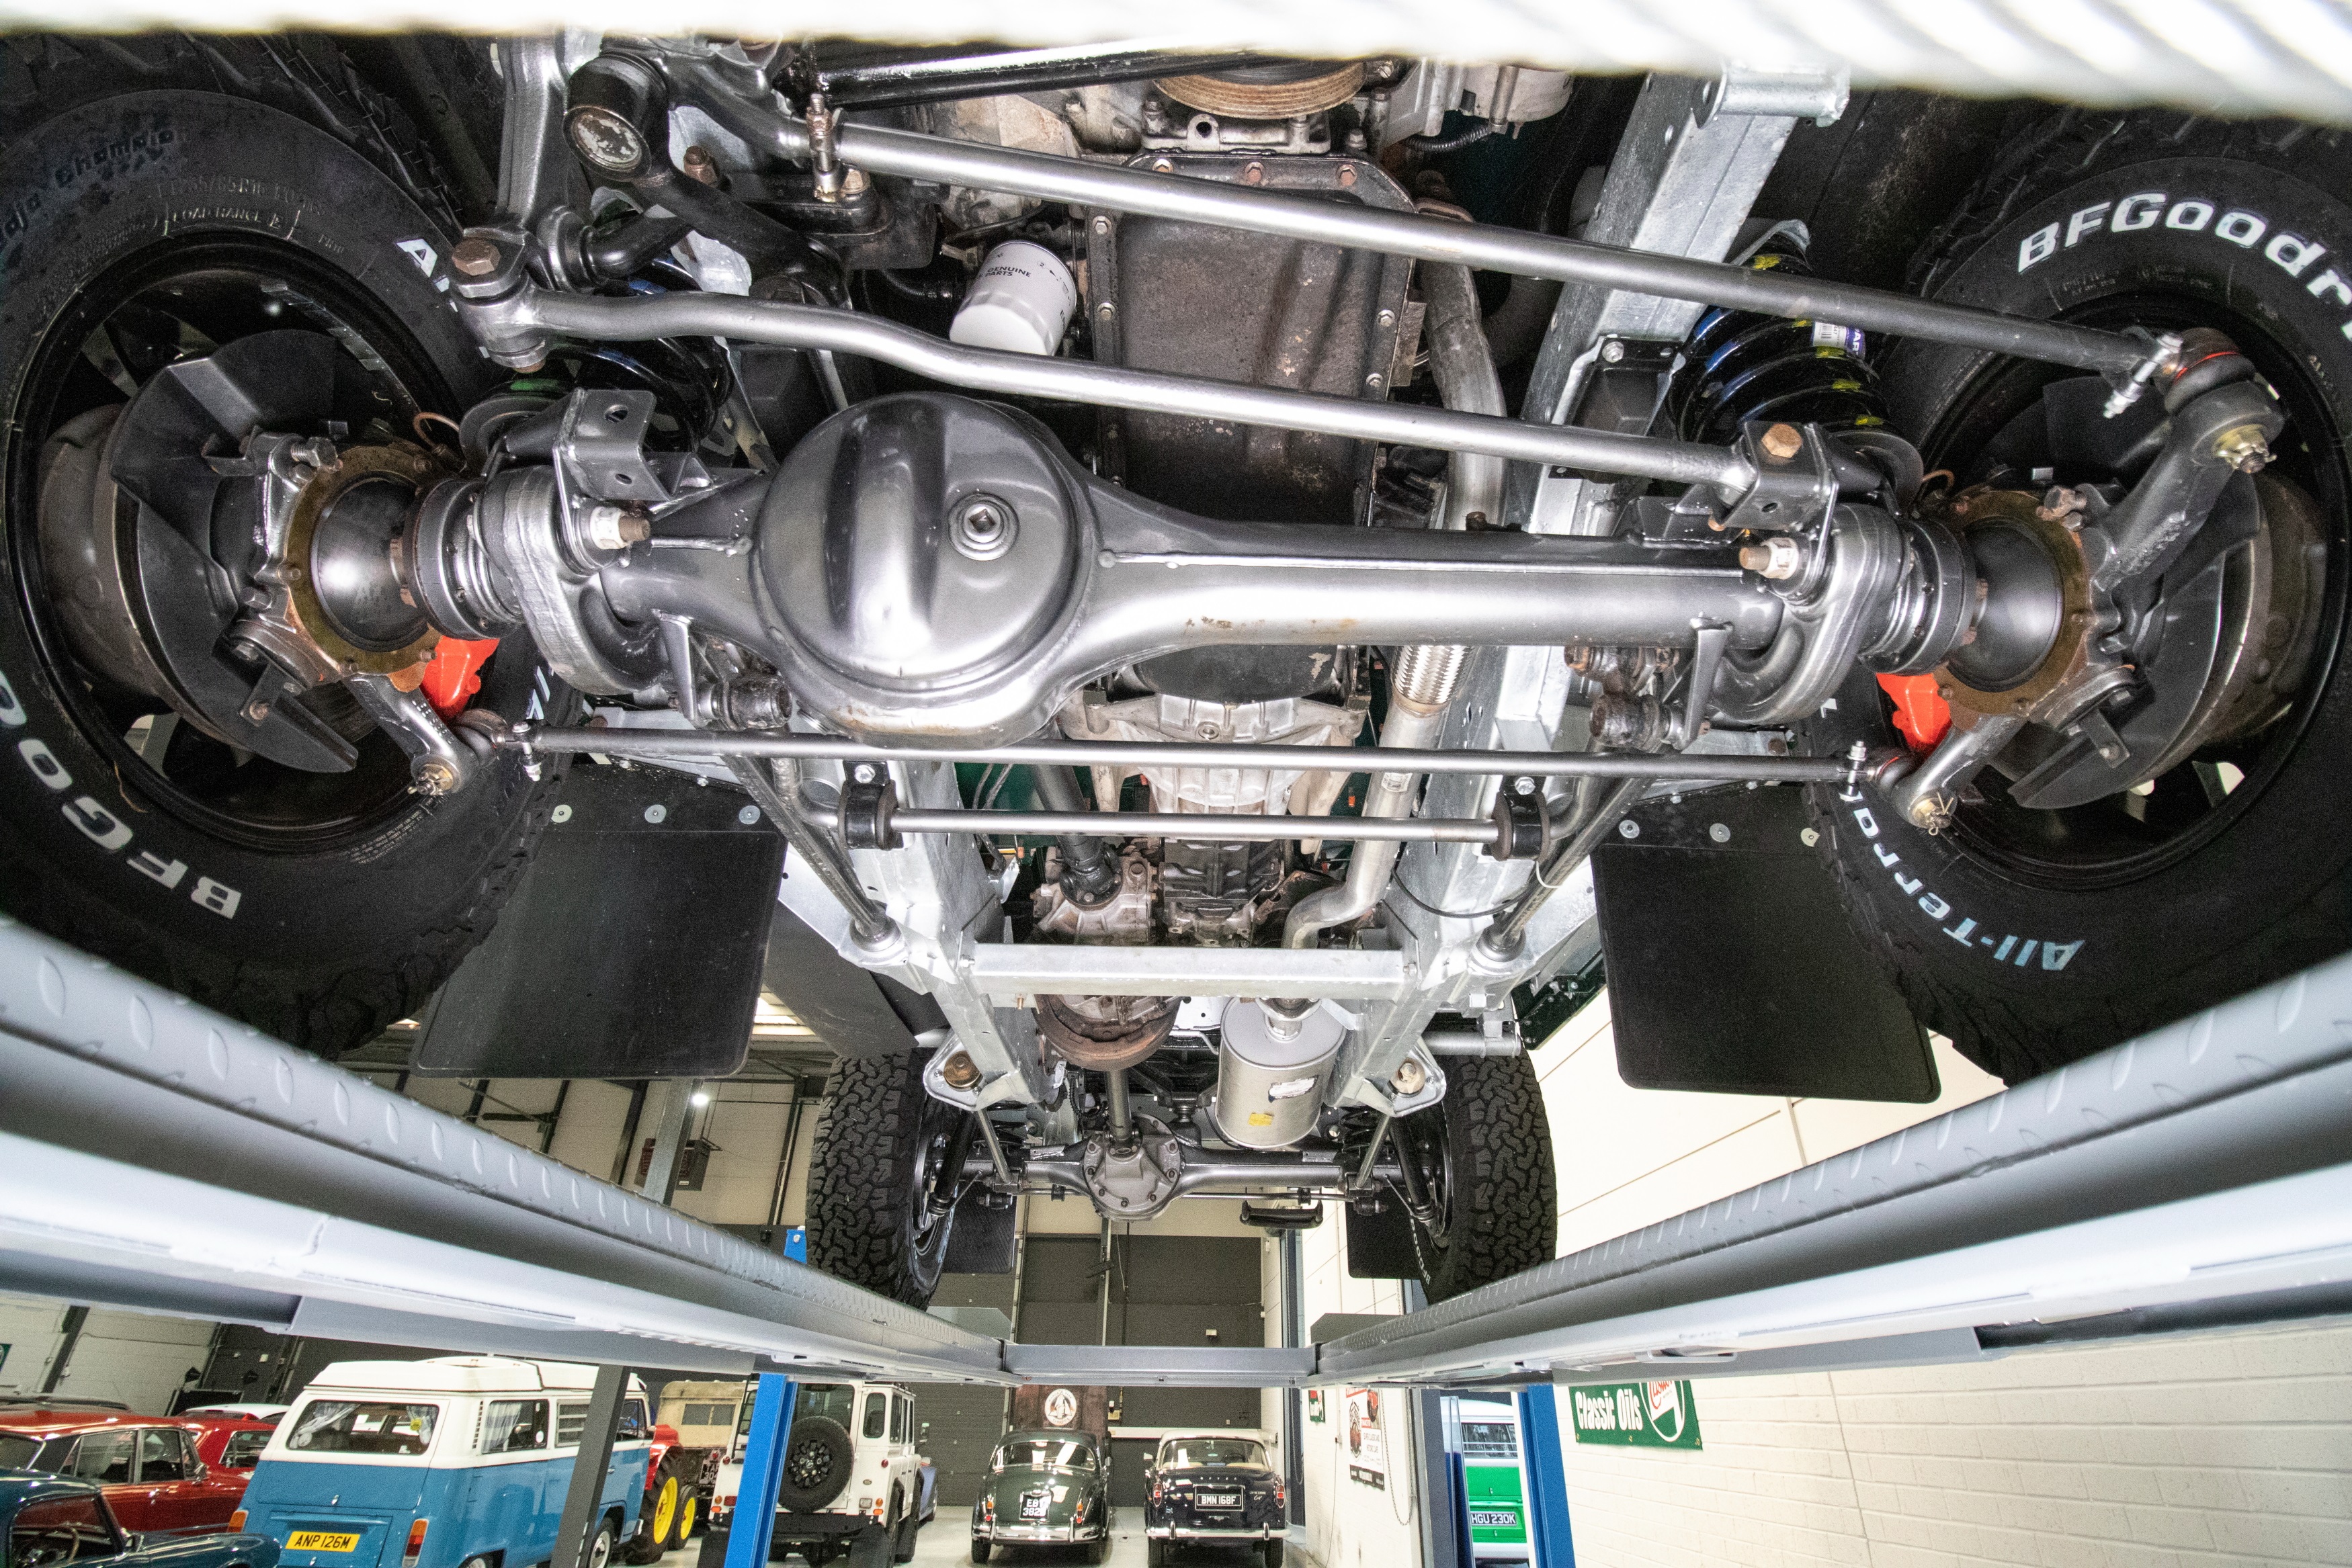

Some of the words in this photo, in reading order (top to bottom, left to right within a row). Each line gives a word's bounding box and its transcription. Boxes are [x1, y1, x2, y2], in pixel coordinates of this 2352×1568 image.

[2017, 192, 2352, 341] BFGoodr
[1574, 1390, 1616, 1430] Classic
[1616, 1388, 1643, 1431] Oils
[1201, 1495, 1217, 1504] BMN
[1218, 1495, 1236, 1504] 168F
[1471, 1514, 1490, 1524] HGU
[1491, 1514, 1516, 1524] 230K
[294, 1534, 321, 1548] ANP
[321, 1536, 351, 1549] 126M
